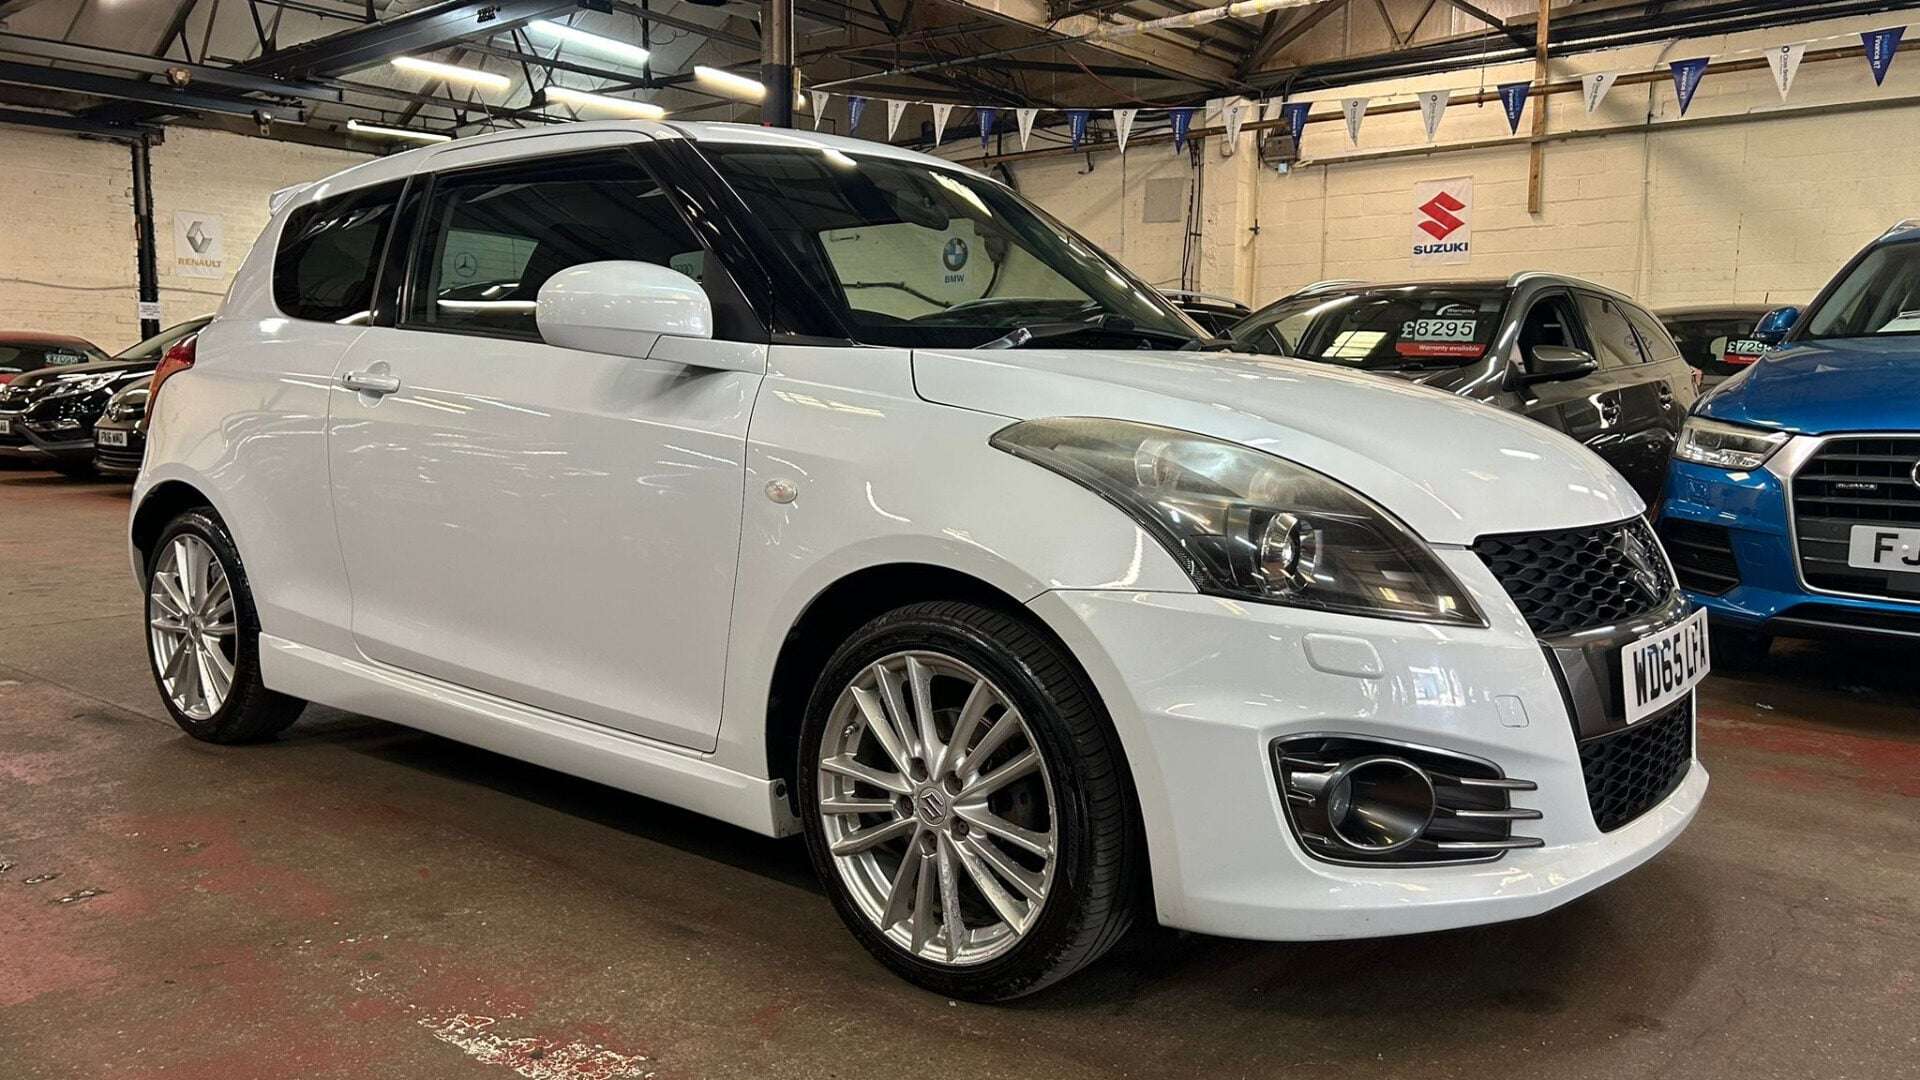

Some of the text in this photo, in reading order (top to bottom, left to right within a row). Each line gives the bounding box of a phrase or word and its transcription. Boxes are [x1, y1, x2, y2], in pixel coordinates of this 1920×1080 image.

[1873, 35, 1882, 60] Finance
[1413, 242, 1469, 255] SUZUKI
[178, 257, 222, 268] RENAULT
[944, 273, 965, 284] BMW
[1400, 321, 1474, 338] £8295
[1419, 344, 1480, 352] Warranty available
